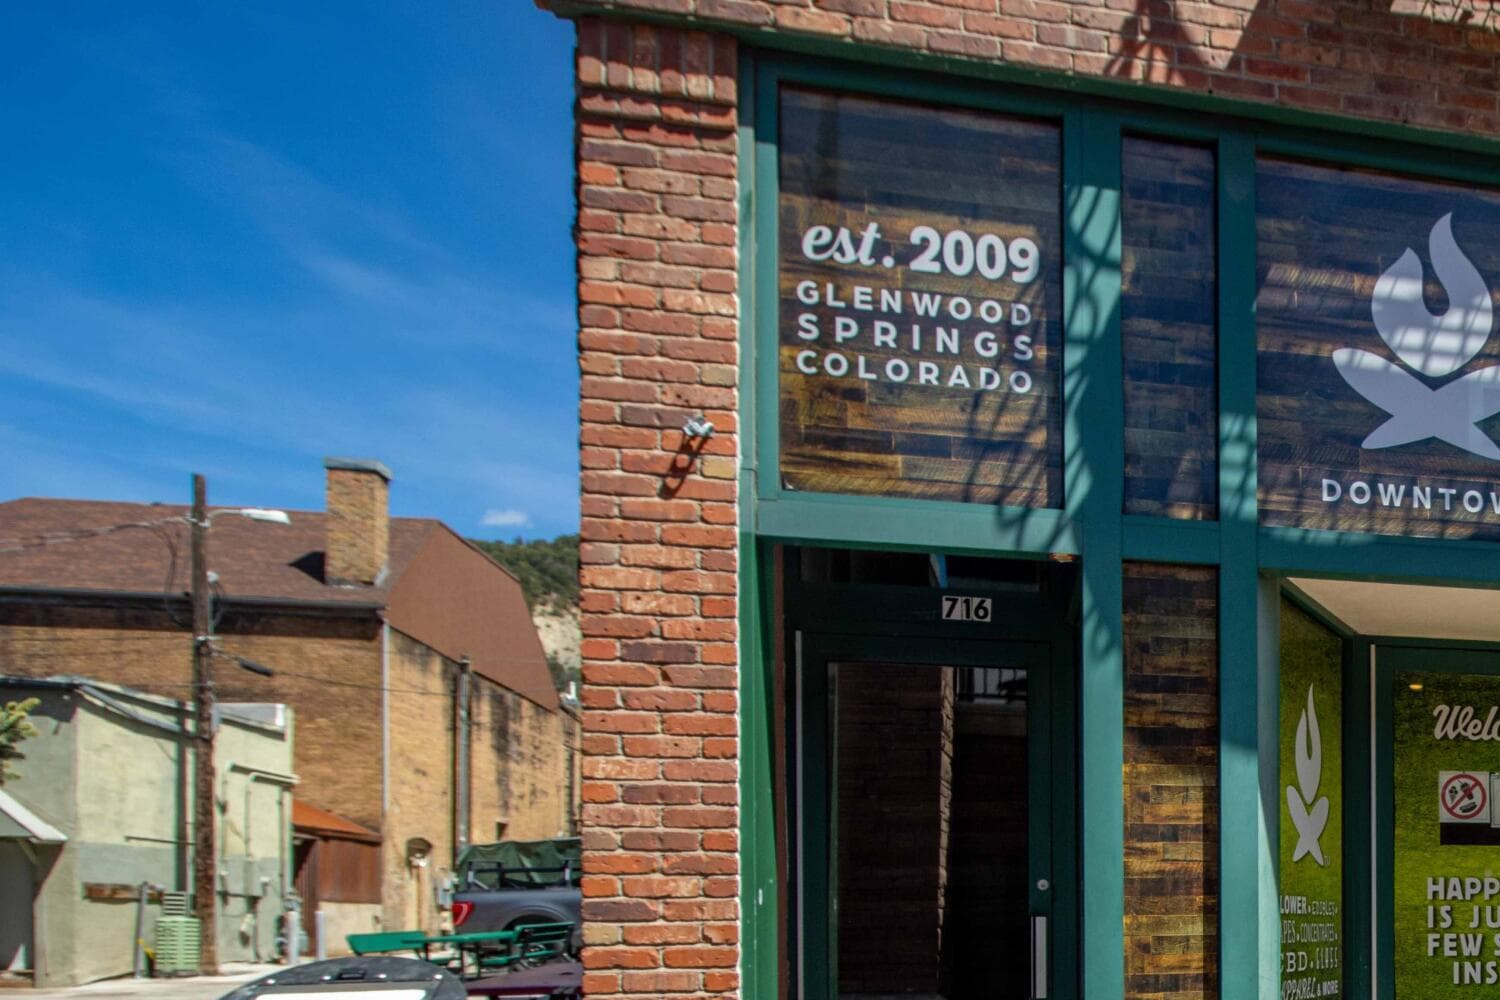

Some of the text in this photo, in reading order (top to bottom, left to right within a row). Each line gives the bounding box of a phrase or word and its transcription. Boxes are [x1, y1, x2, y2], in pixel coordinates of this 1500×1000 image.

[801, 222, 1040, 284] est. 2009
[797, 280, 1032, 327] GLENWOOD
[797, 313, 1033, 360] SPRINGS
[797, 350, 1032, 394] COLORADO
[944, 597, 989, 620] 716
[1280, 895, 1307, 915] LOWER
[1427, 905, 1453, 929] IS
[1280, 920, 1296, 944] PES
[1427, 933, 1483, 957] FEW
[1322, 980, 1339, 995] MORE
